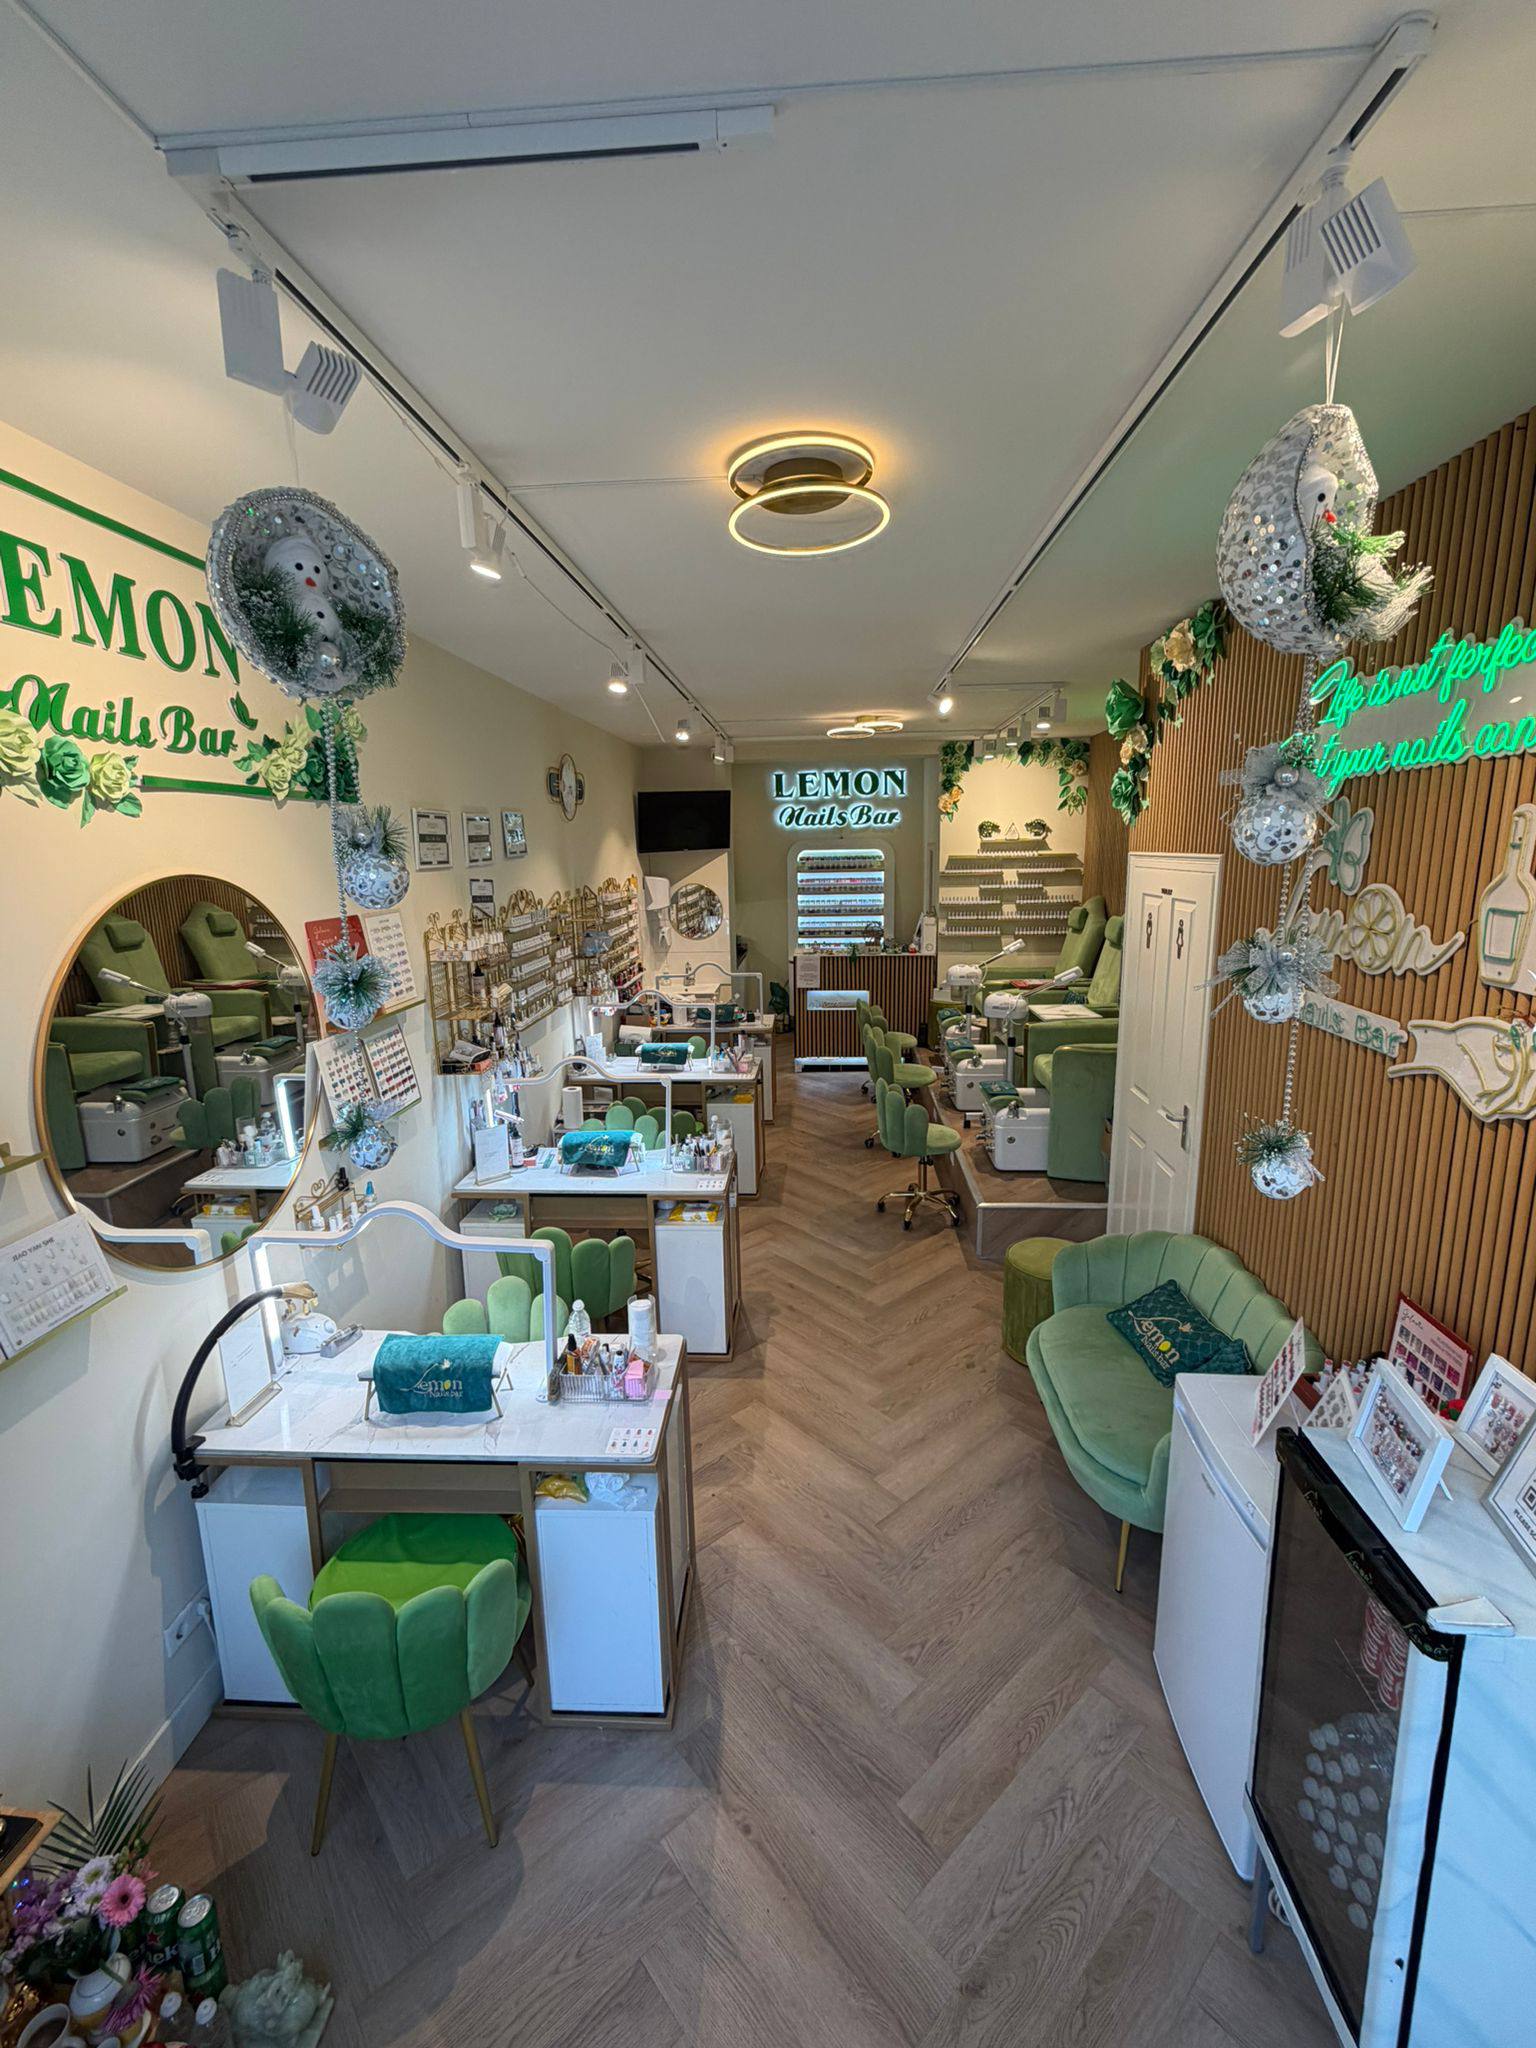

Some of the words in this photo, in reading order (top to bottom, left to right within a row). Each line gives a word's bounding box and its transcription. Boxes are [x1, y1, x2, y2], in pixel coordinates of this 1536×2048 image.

[1309, 659, 1367, 729] Life
[1367, 668, 1394, 707] is
[1394, 633, 1453, 697] not
[160, 705, 238, 757] Bar
[1326, 741, 1390, 799] your
[1389, 698, 1472, 768] nails
[1474, 716, 1536, 756] can
[774, 769, 906, 798] LEMON
[779, 805, 848, 827] Nails
[850, 804, 900, 826] Bar
[1299, 1002, 1345, 1034] ails
[1354, 1014, 1405, 1055] Bar
